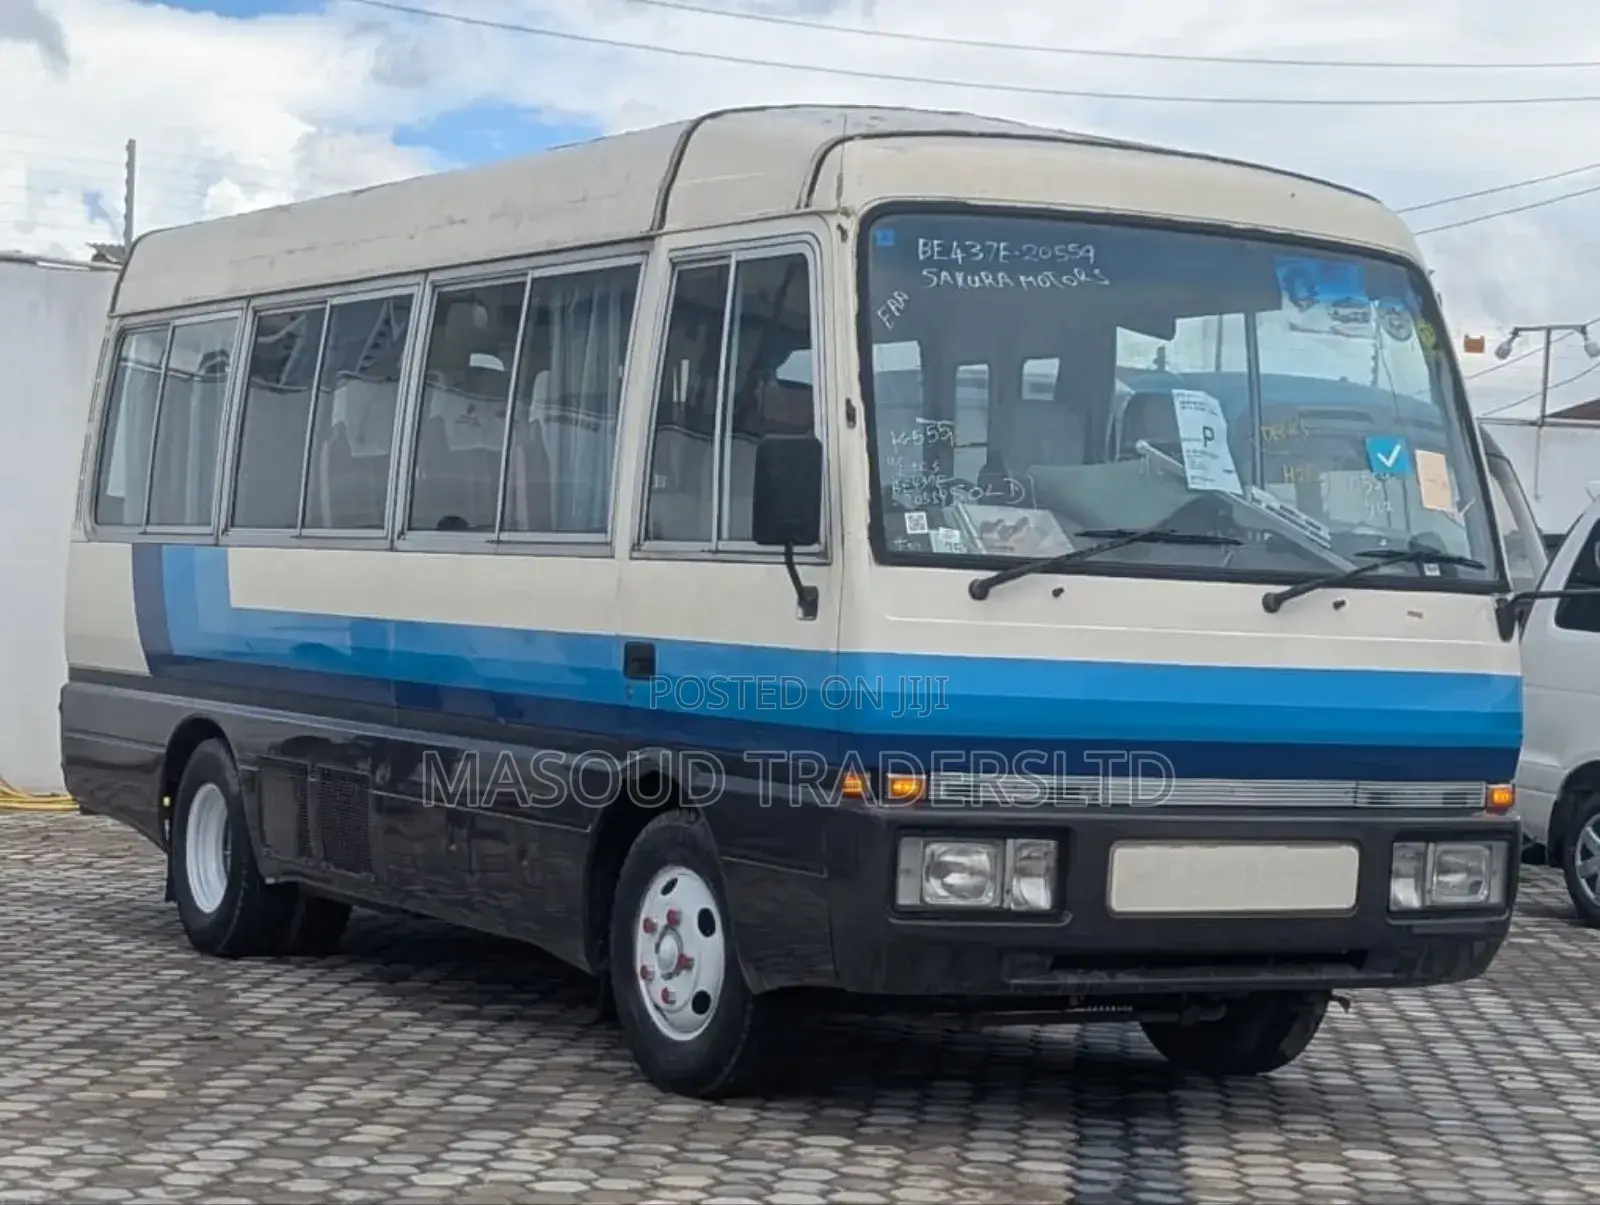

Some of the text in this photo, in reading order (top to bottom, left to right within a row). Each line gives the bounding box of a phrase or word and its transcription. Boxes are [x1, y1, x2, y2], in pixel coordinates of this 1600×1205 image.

[921, 268, 1111, 290] SAKURA MOTORS
[1202, 425, 1216, 448] P
